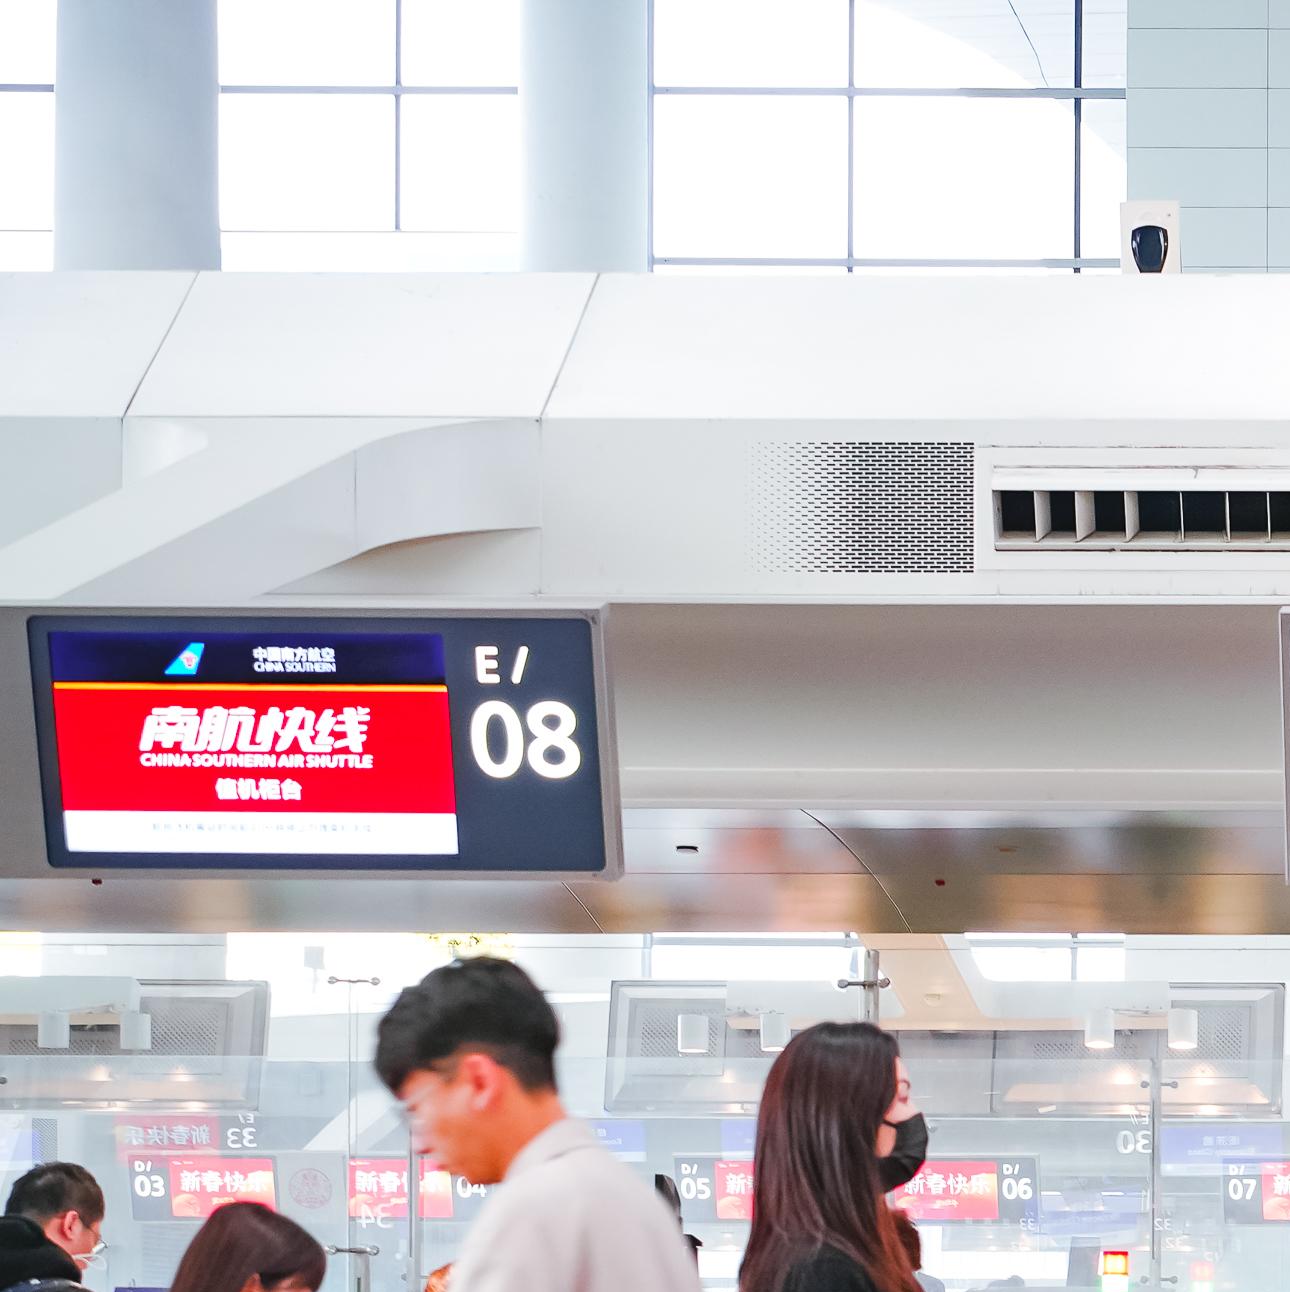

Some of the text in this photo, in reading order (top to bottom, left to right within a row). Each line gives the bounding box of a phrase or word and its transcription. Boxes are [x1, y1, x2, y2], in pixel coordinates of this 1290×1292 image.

[253, 661, 337, 673] CHINA SOUTHERN
[475, 646, 529, 684] E/
[138, 706, 371, 753] 南航快线
[470, 700, 581, 779] 08
[139, 753, 374, 769] CHINA SOUTHERN AIR SHUTTLE
[215, 778, 302, 800] 值机柜台
[134, 1175, 165, 1198] 03
[179, 1170, 269, 1193] 新春快乐
[680, 1177, 711, 1200] 05
[904, 1173, 992, 1195] 新春快乐
[1002, 1178, 1032, 1200] 06
[1228, 1179, 1257, 1200] 07
